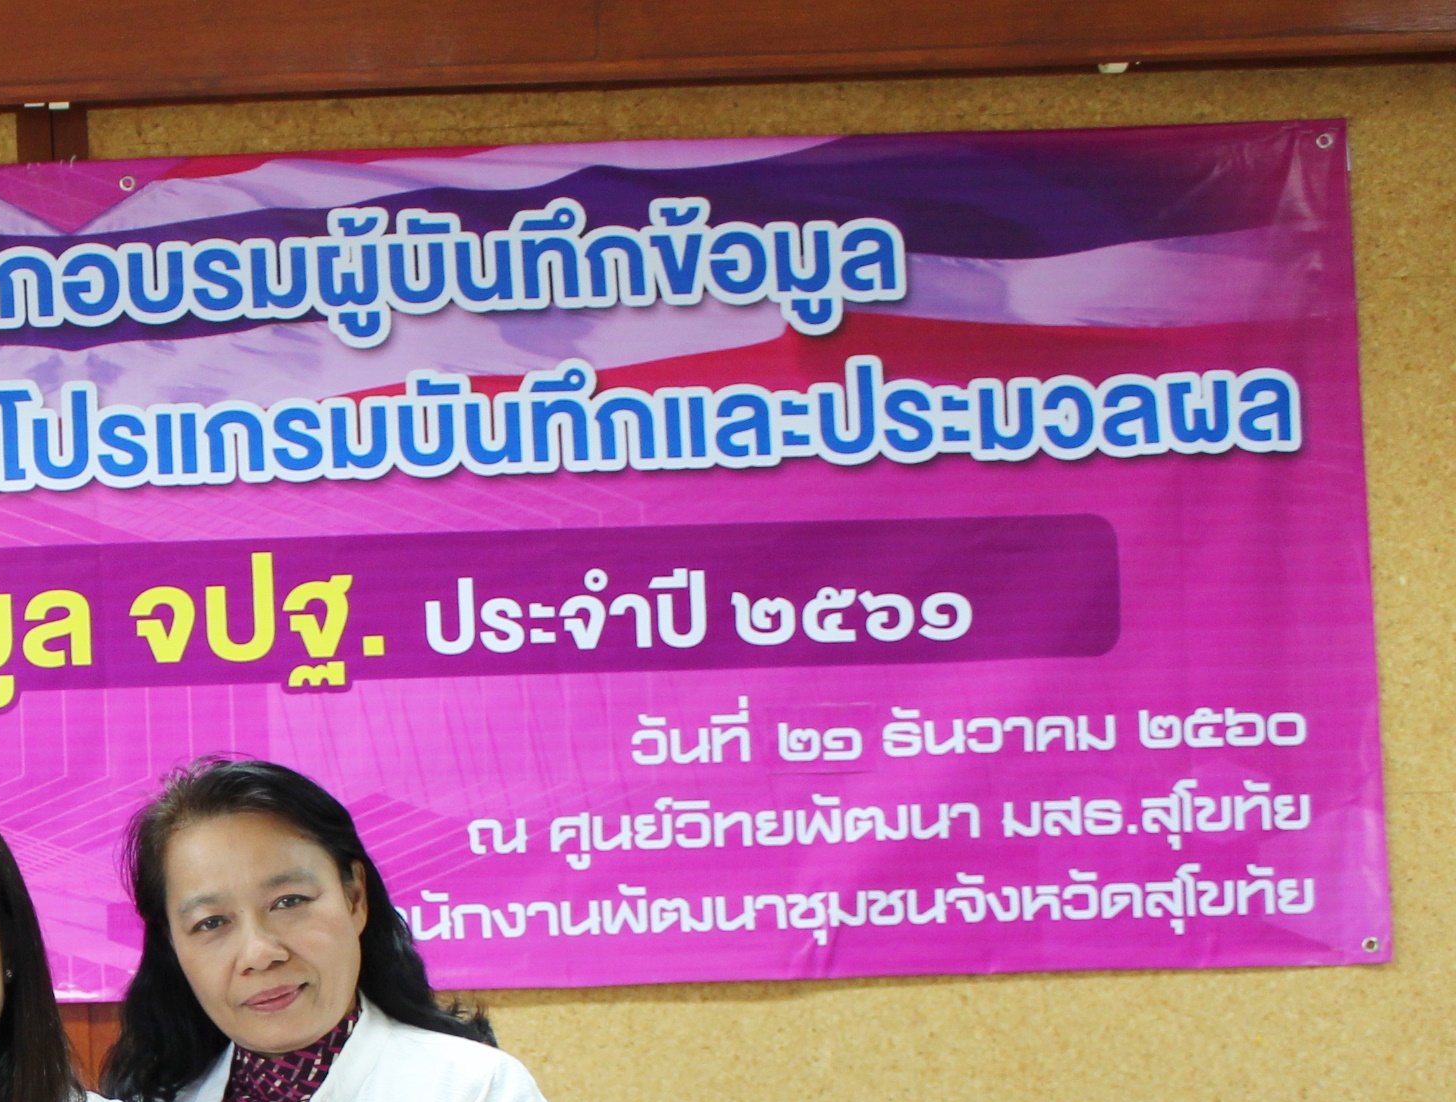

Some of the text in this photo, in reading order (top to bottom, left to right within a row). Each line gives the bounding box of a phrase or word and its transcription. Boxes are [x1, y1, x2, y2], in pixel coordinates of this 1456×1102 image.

[129, 551, 386, 688] จปฐ.
[424, 567, 708, 656] ประจำปี
[730, 586, 973, 647] ๒๕๖๑
[630, 695, 1308, 766] วันที่ ๒๑ ธันวาคม ๒๕๖๐
[466, 779, 1312, 872] ณ ศูนย์วิทยพัฒนา มสธ.สุโขทัย
[393, 862, 1316, 946] นักงานพัฒนาชุมชนจังหวัดสุโขทัย
